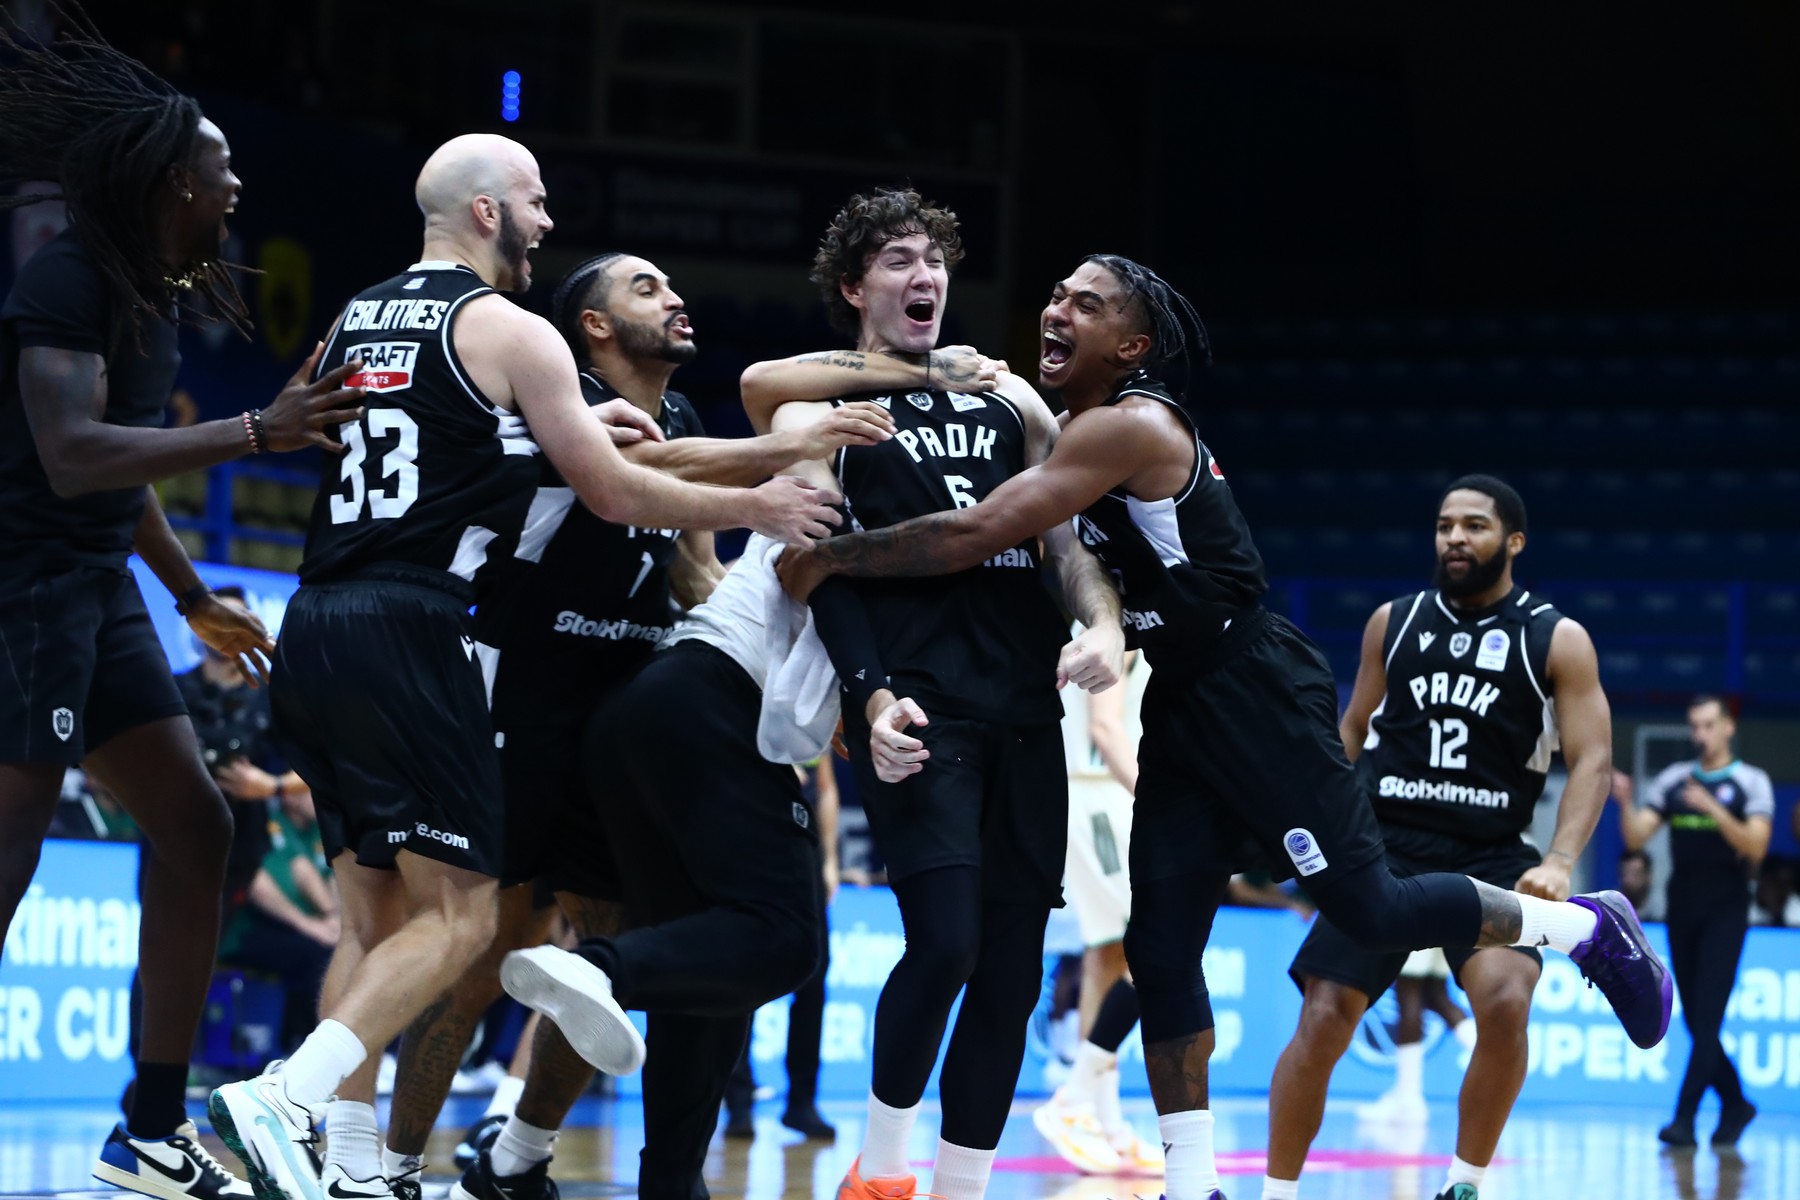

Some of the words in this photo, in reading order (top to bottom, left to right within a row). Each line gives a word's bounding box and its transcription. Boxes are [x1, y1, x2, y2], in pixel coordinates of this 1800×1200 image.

[343, 299, 450, 331] CALATHES
[894, 422, 998, 463] PAOK
[330, 408, 419, 524] 33
[1409, 671, 1501, 717] PAOK
[1428, 718, 1468, 769] 12
[1379, 775, 1509, 808] Stoiximan
[387, 821, 470, 849] me.com
